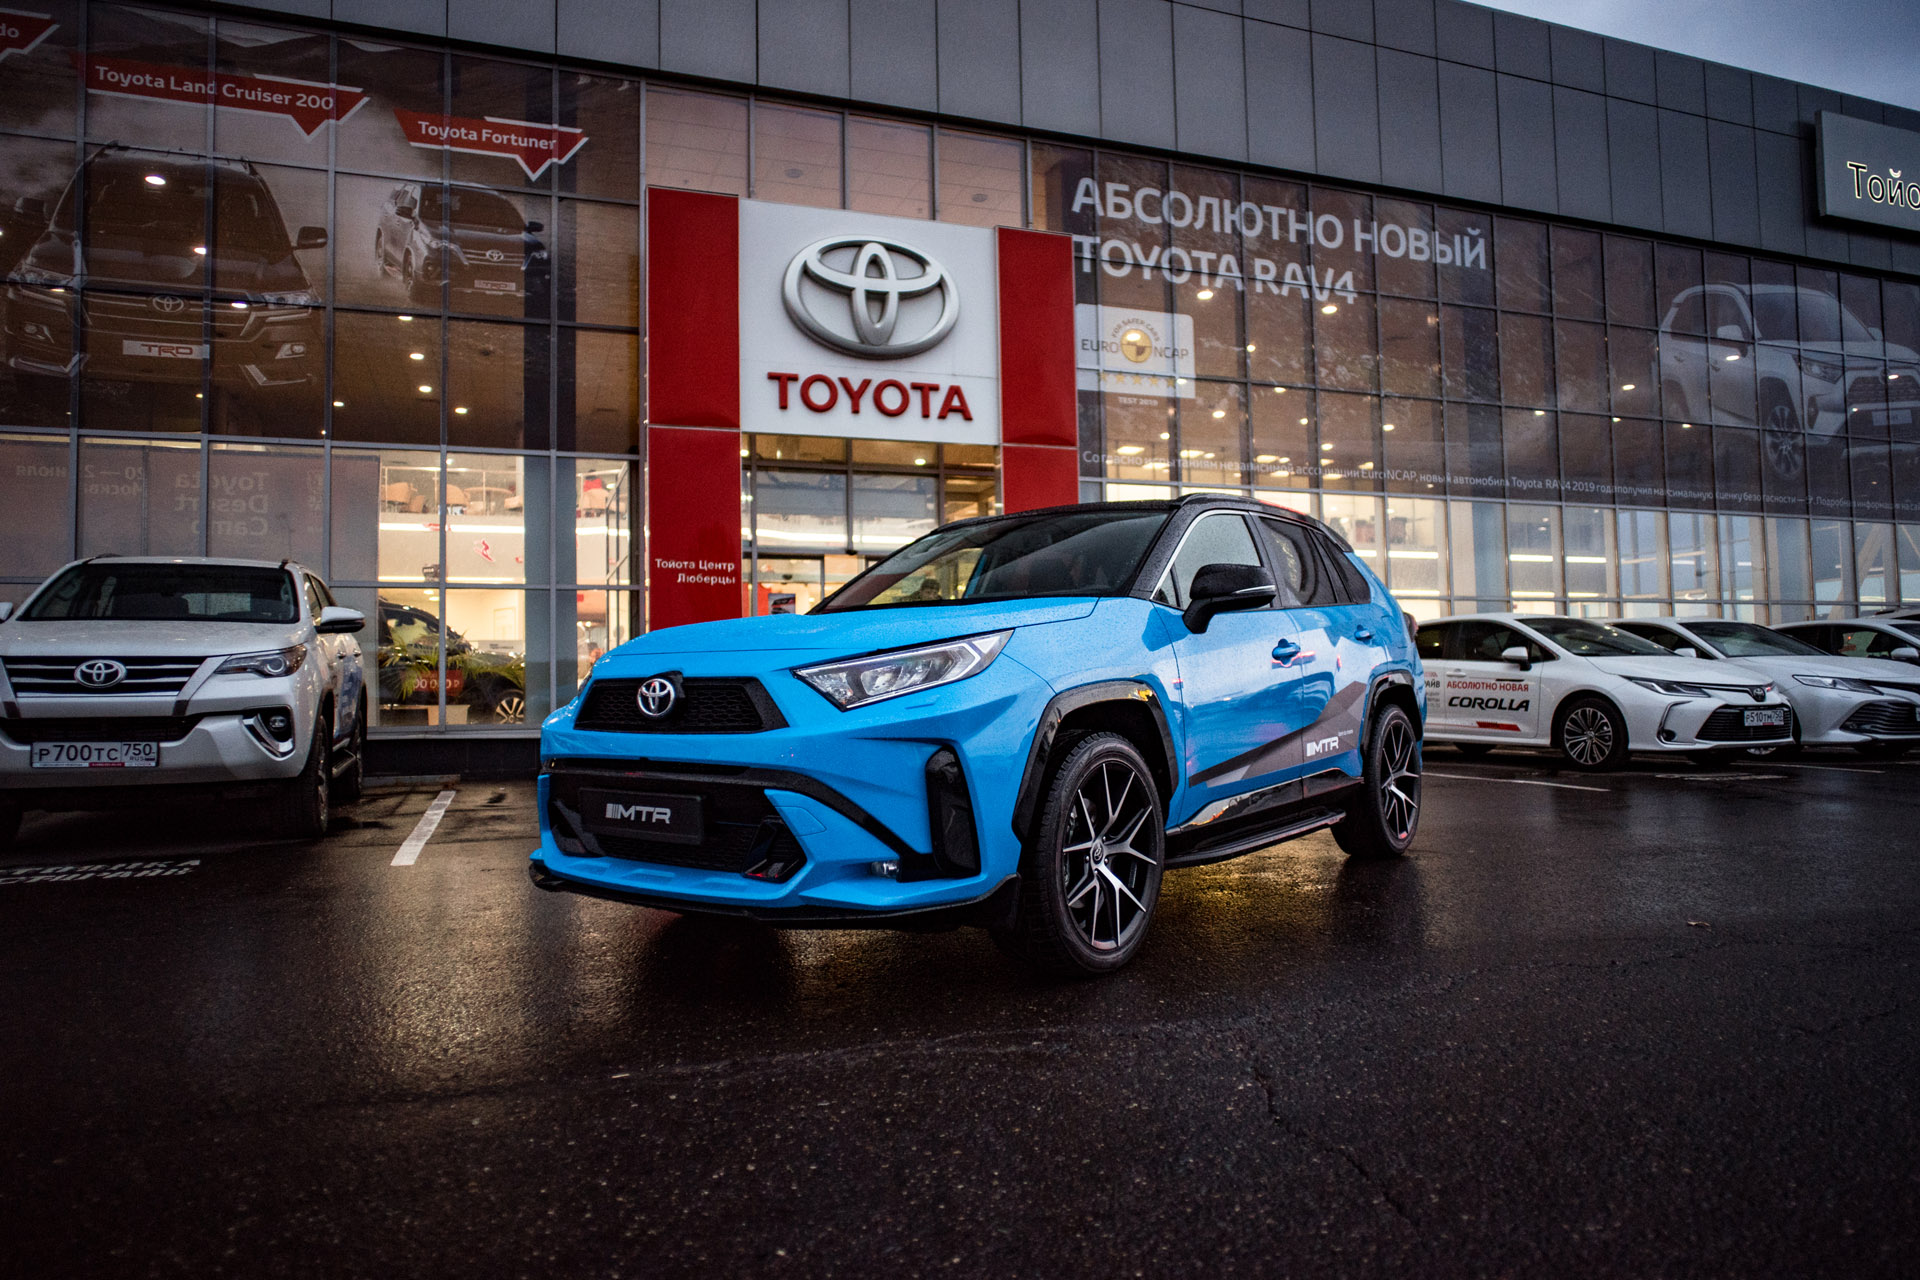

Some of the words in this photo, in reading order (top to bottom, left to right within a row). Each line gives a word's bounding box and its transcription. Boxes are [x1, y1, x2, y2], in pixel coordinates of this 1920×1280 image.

[95, 65, 165, 88] Toyota
[170, 76, 216, 95] Land
[222, 83, 292, 105] Cruiser
[295, 93, 334, 110] 200
[418, 121, 478, 141] Toyota
[481, 129, 557, 150] Fortuner
[1847, 161, 1920, 210] Тойо
[1071, 177, 1344, 249] АБСОЛЮТНО
[1353, 218, 1486, 270] НОВЫЙ
[1072, 234, 1243, 291] TOYOTA
[1254, 257, 1358, 305] RAV4
[141, 343, 194, 357] TRD
[1081, 338, 1119, 353] EURO
[1153, 346, 1189, 359] NCAP
[767, 371, 973, 421] TOYOTA
[1511, 476, 1543, 491] Toyota
[1572, 481, 1595, 493] 2019
[655, 558, 696, 570] Тойота
[698, 560, 735, 573] Центр
[676, 573, 736, 586] Люберцы
[1446, 680, 1497, 691] АБСОЛЮТНО
[1499, 682, 1529, 692] НОВАЯ
[1448, 696, 1530, 712] COROLLA
[123, 743, 153, 756] 750
[1309, 736, 1339, 755] MTR
[609, 803, 671, 824] MTR
